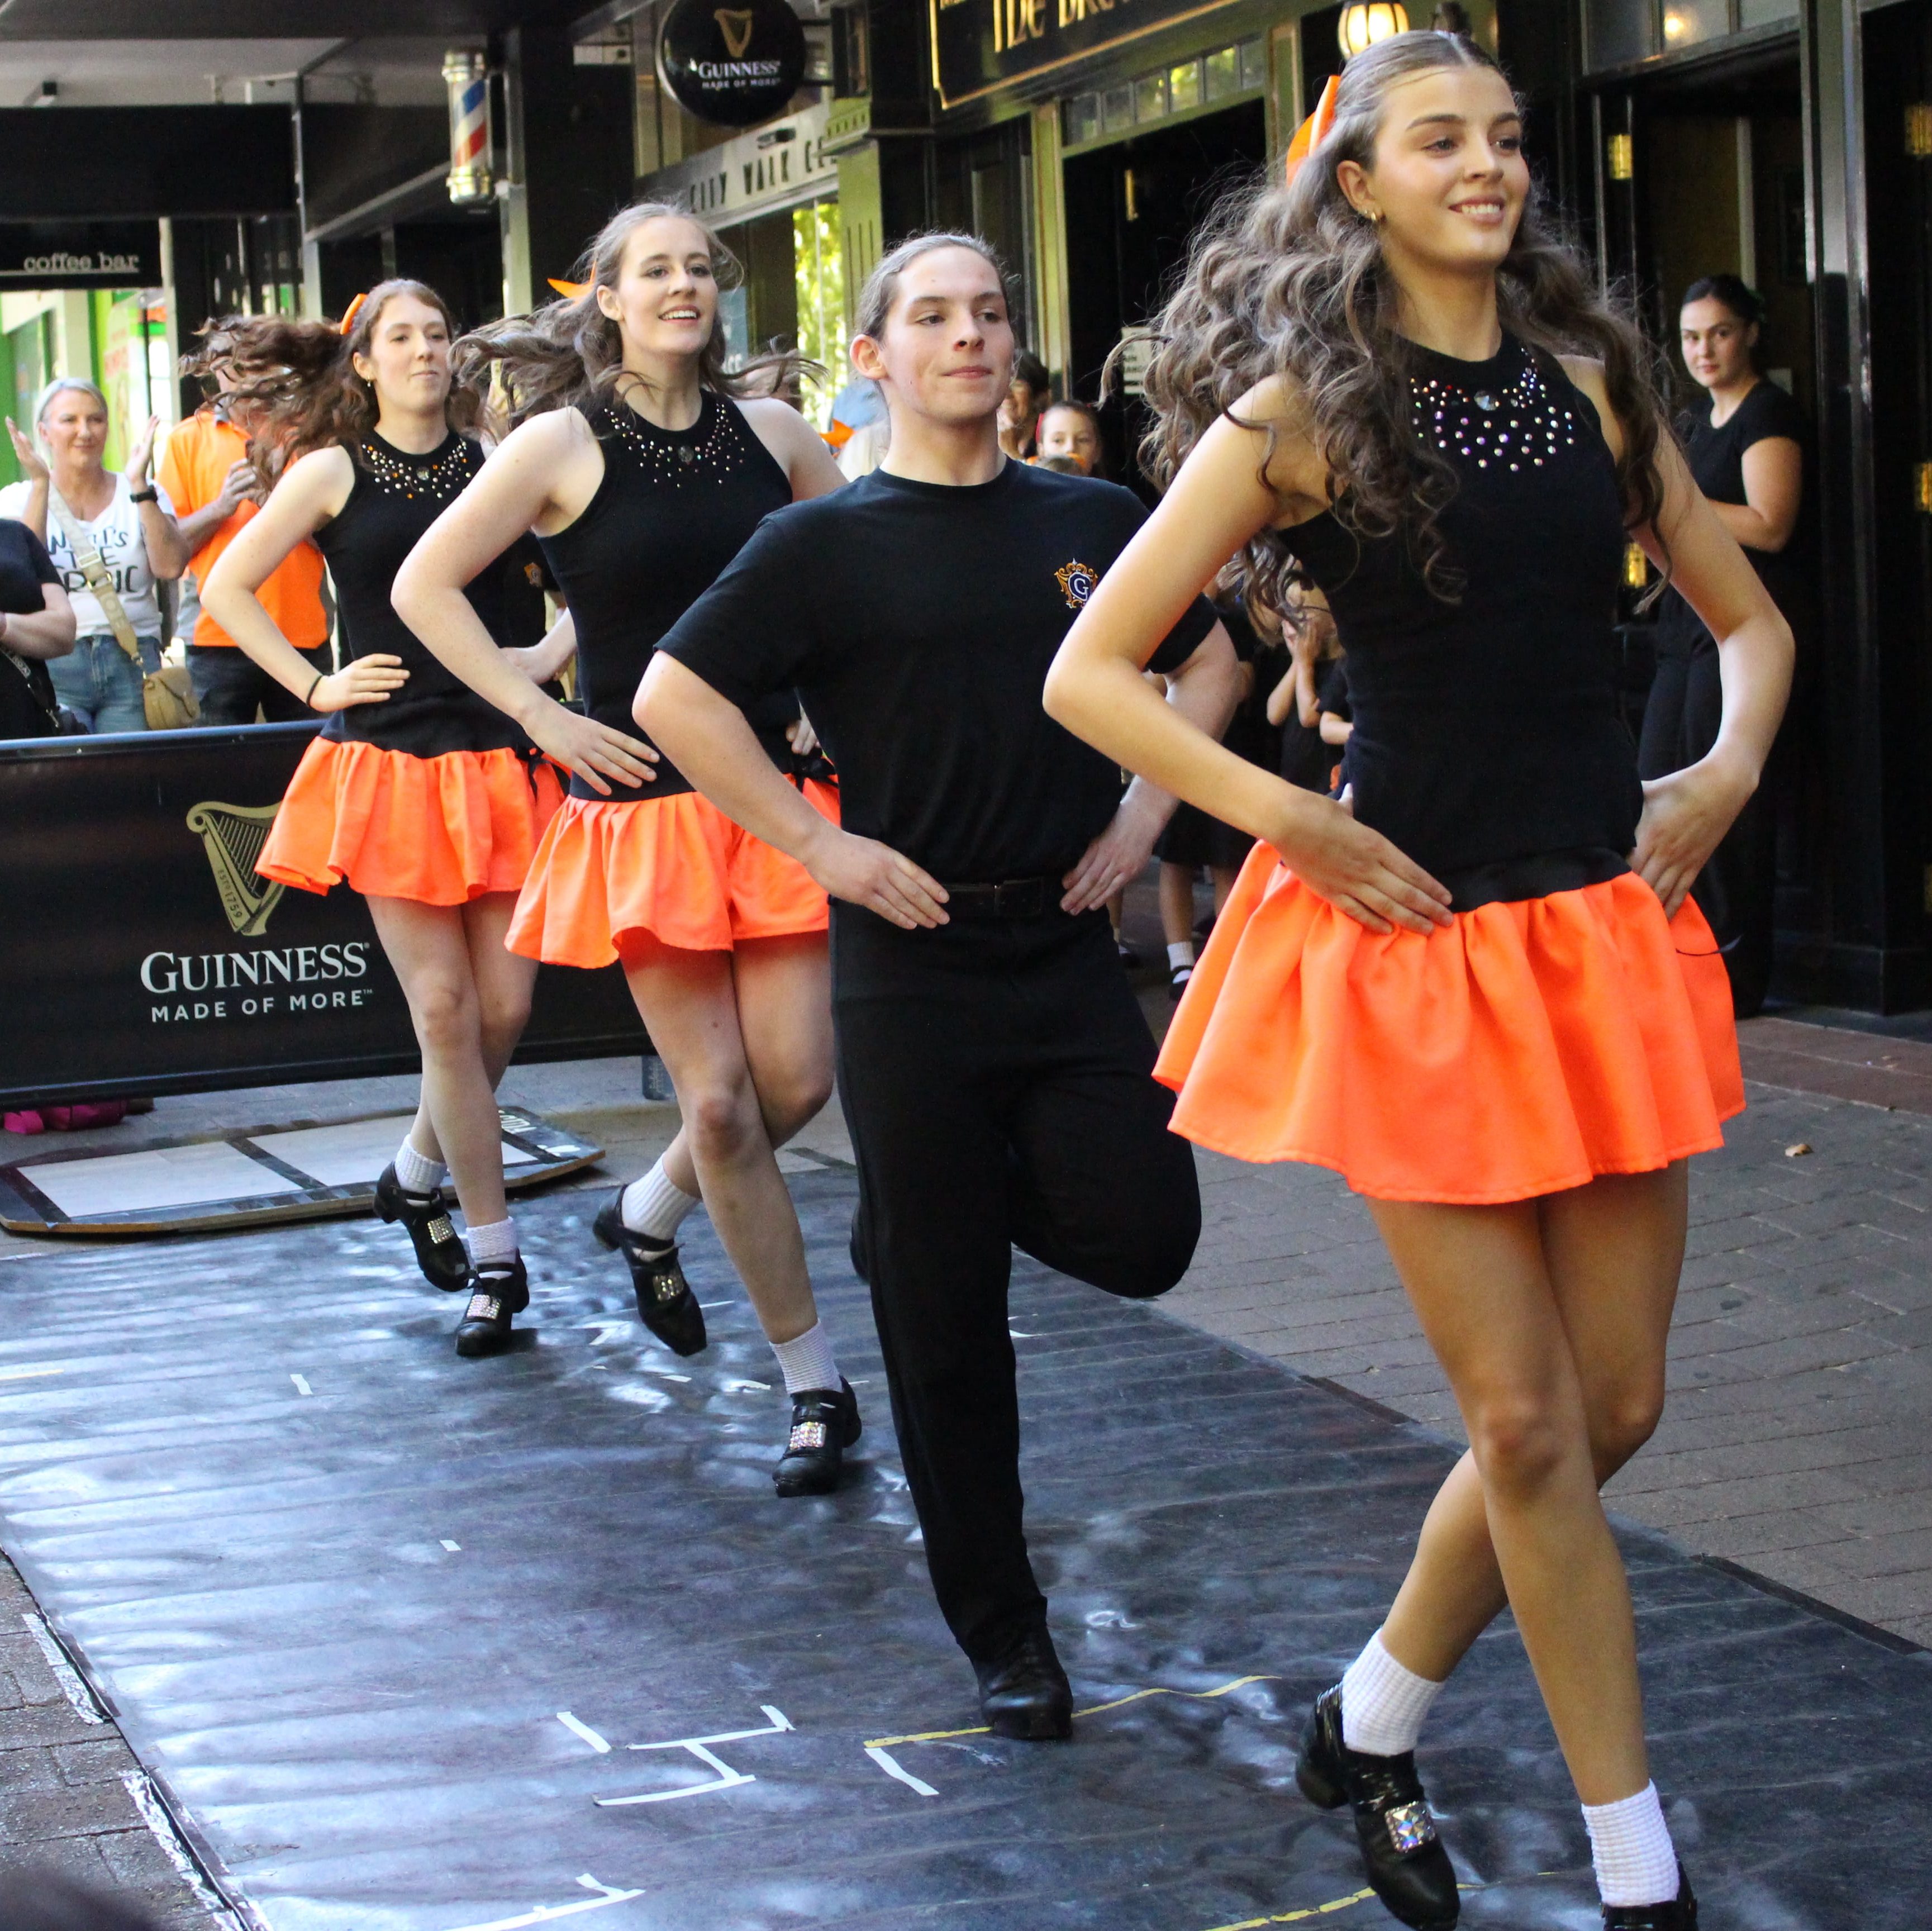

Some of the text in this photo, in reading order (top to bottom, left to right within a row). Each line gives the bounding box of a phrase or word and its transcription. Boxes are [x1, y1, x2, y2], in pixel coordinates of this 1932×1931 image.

[698, 60, 779, 79] GUINNESS
[689, 172, 726, 213] CITY
[743, 149, 788, 196] WALK
[23, 251, 139, 273] coffee bar
[225, 892, 243, 918] 1759
[140, 942, 367, 994] GUINNESS
[151, 990, 364, 1023] MADE OF MORE
